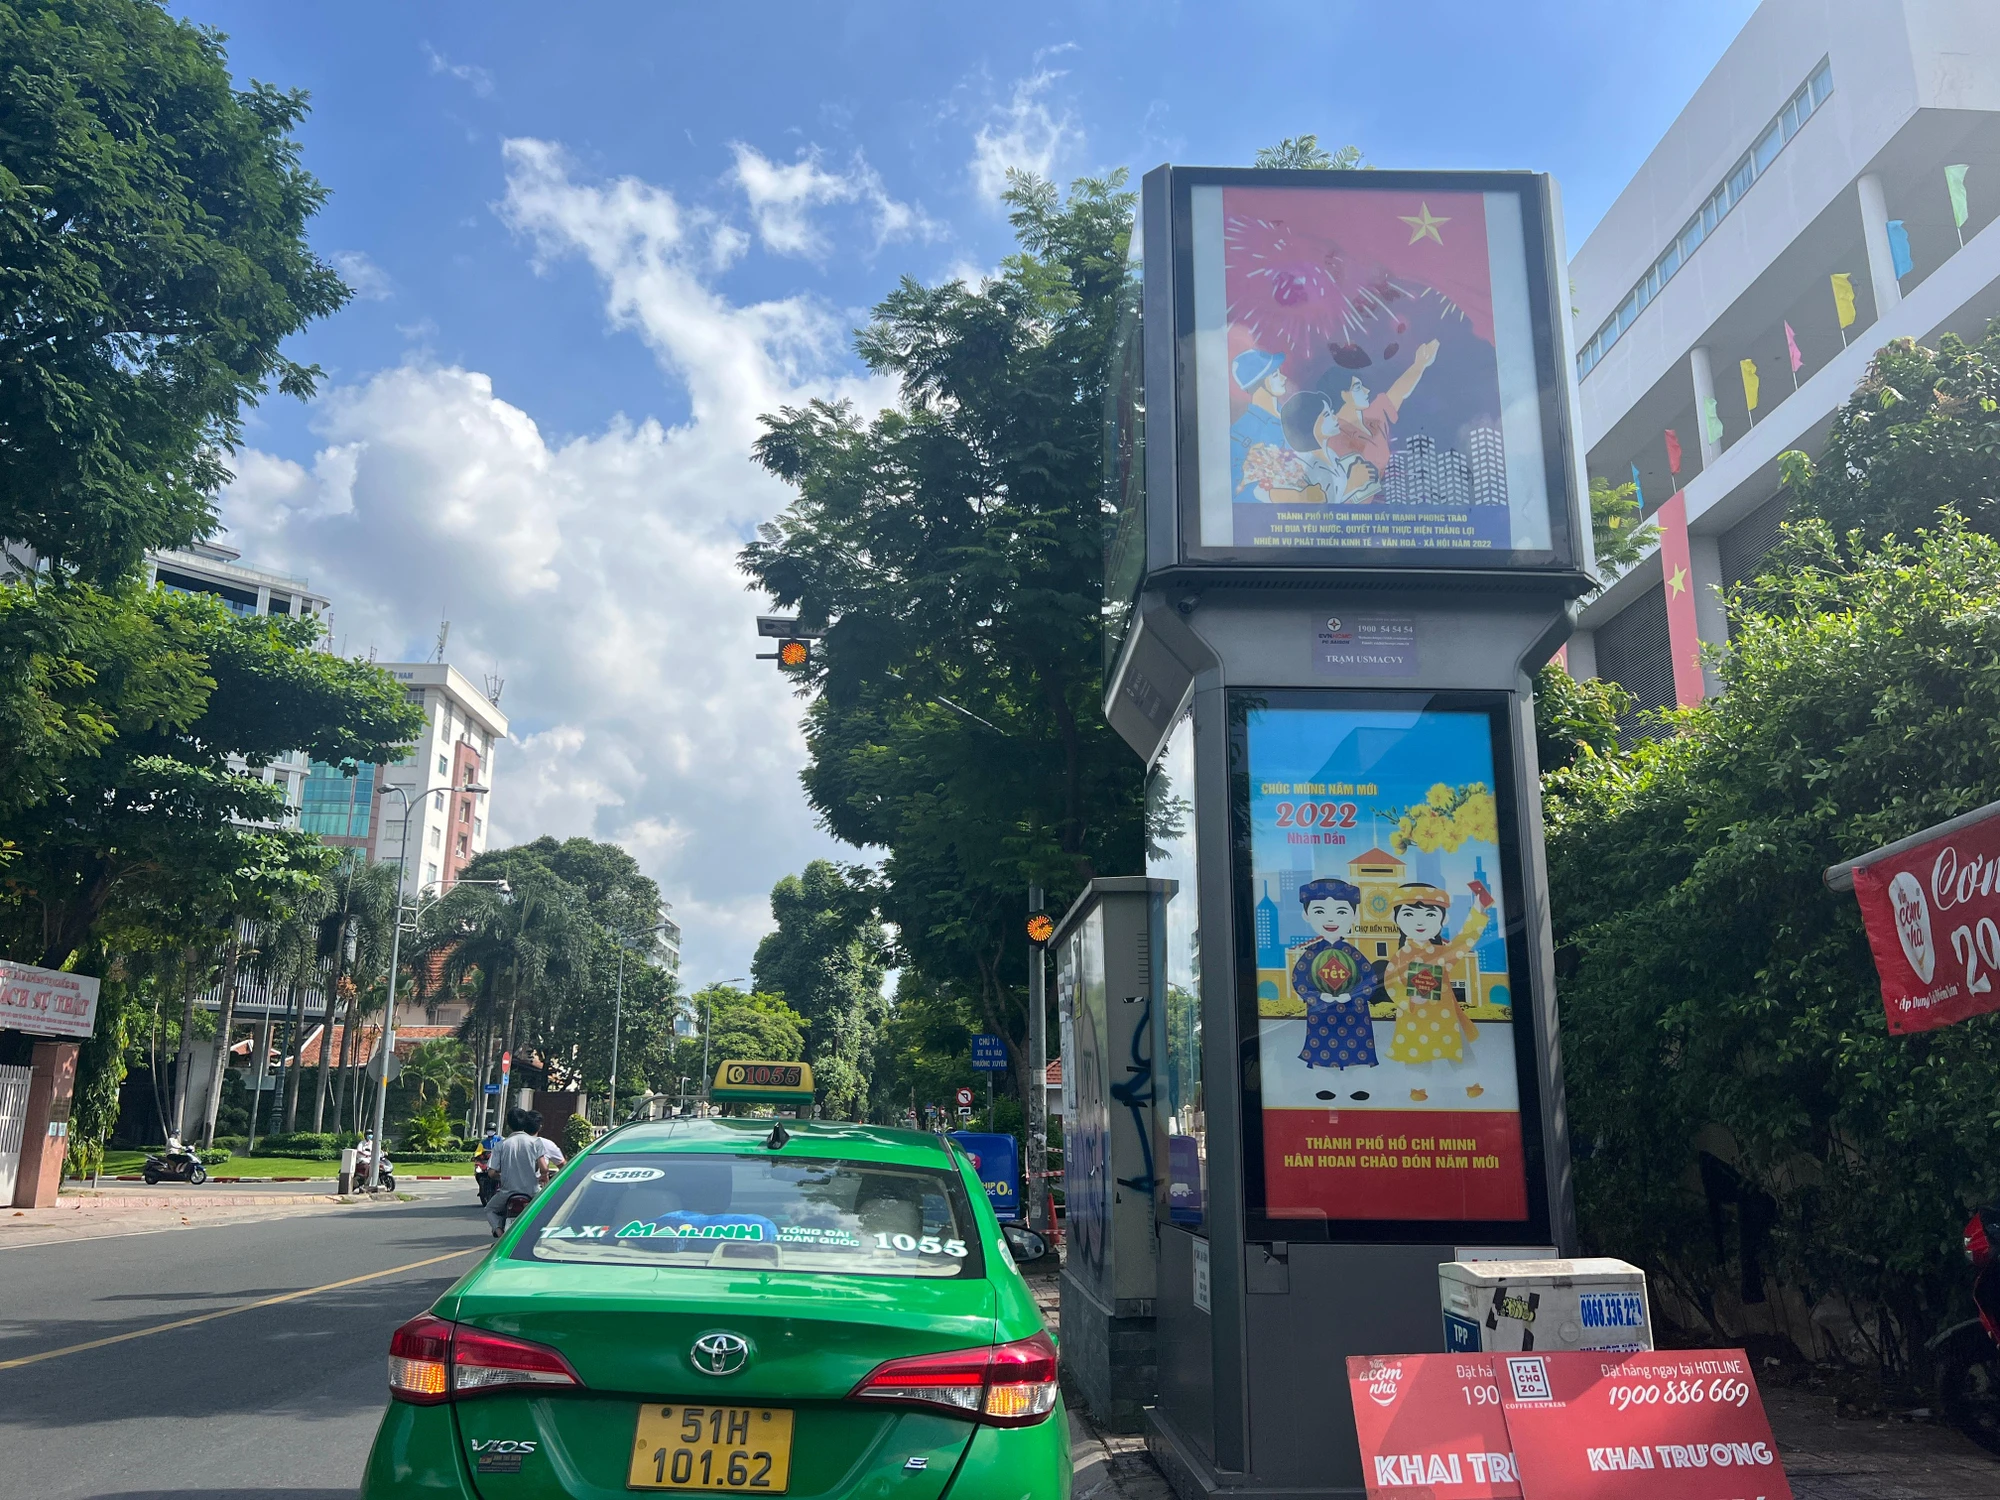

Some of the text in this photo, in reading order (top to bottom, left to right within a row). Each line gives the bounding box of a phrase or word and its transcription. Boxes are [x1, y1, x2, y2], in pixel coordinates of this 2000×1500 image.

[1352, 513, 1373, 521] MINH
[1418, 514, 1445, 522] PHONG
[1271, 525, 1282, 533] THI
[1341, 538, 1360, 546] KINH
[1472, 540, 1492, 548] 2022
[1358, 625, 1413, 633] 1900 54 54 54
[1325, 655, 1404, 664] TRẠM USMACVY
[1262, 782, 1379, 796] CHÚC MỪNG NĂM MỚI
[1276, 802, 1357, 829] 2022
[1287, 831, 1346, 845] Nhâm Dần
[1355, 924, 1401, 933] CHỢ BẾN THÀN
[1322, 965, 1346, 979] Tết
[978, 1036, 990, 1046] CHÚ
[746, 1066, 800, 1085] 1055
[1306, 1134, 1476, 1151] THÀNH PHỐ HỒ CHÍ MINH
[1284, 1153, 1500, 1169] HÂN HOAN CHÀO ĐÓN NĂM MỚI
[602, 1170, 654, 1179] 5389
[781, 1225, 850, 1238] TỔNG ĐÀI
[775, 1233, 860, 1247] TOÀN QUỐC
[873, 1232, 969, 1258] 1055
[1453, 1324, 1469, 1346] TPP
[1368, 1367, 1404, 1381] cơm
[1456, 1364, 1495, 1380] Đặt hà
[1516, 1365, 1538, 1373] FLE
[1601, 1360, 1744, 1380] Đặt hàng ngay tại HOTLINE
[1369, 1379, 1398, 1394] nhà
[1461, 1385, 1500, 1405] 190
[1608, 1378, 1750, 1412] 1900 886 669
[1535, 1401, 1567, 1409] EXPRESS
[681, 1408, 749, 1445] 51H
[471, 1438, 538, 1454] VIOS
[904, 1456, 929, 1470] E
[1586, 1441, 1774, 1472] KHAI TRƯƠNG
[653, 1448, 772, 1487] 101.62
[1373, 1453, 1463, 1486] KHAI
